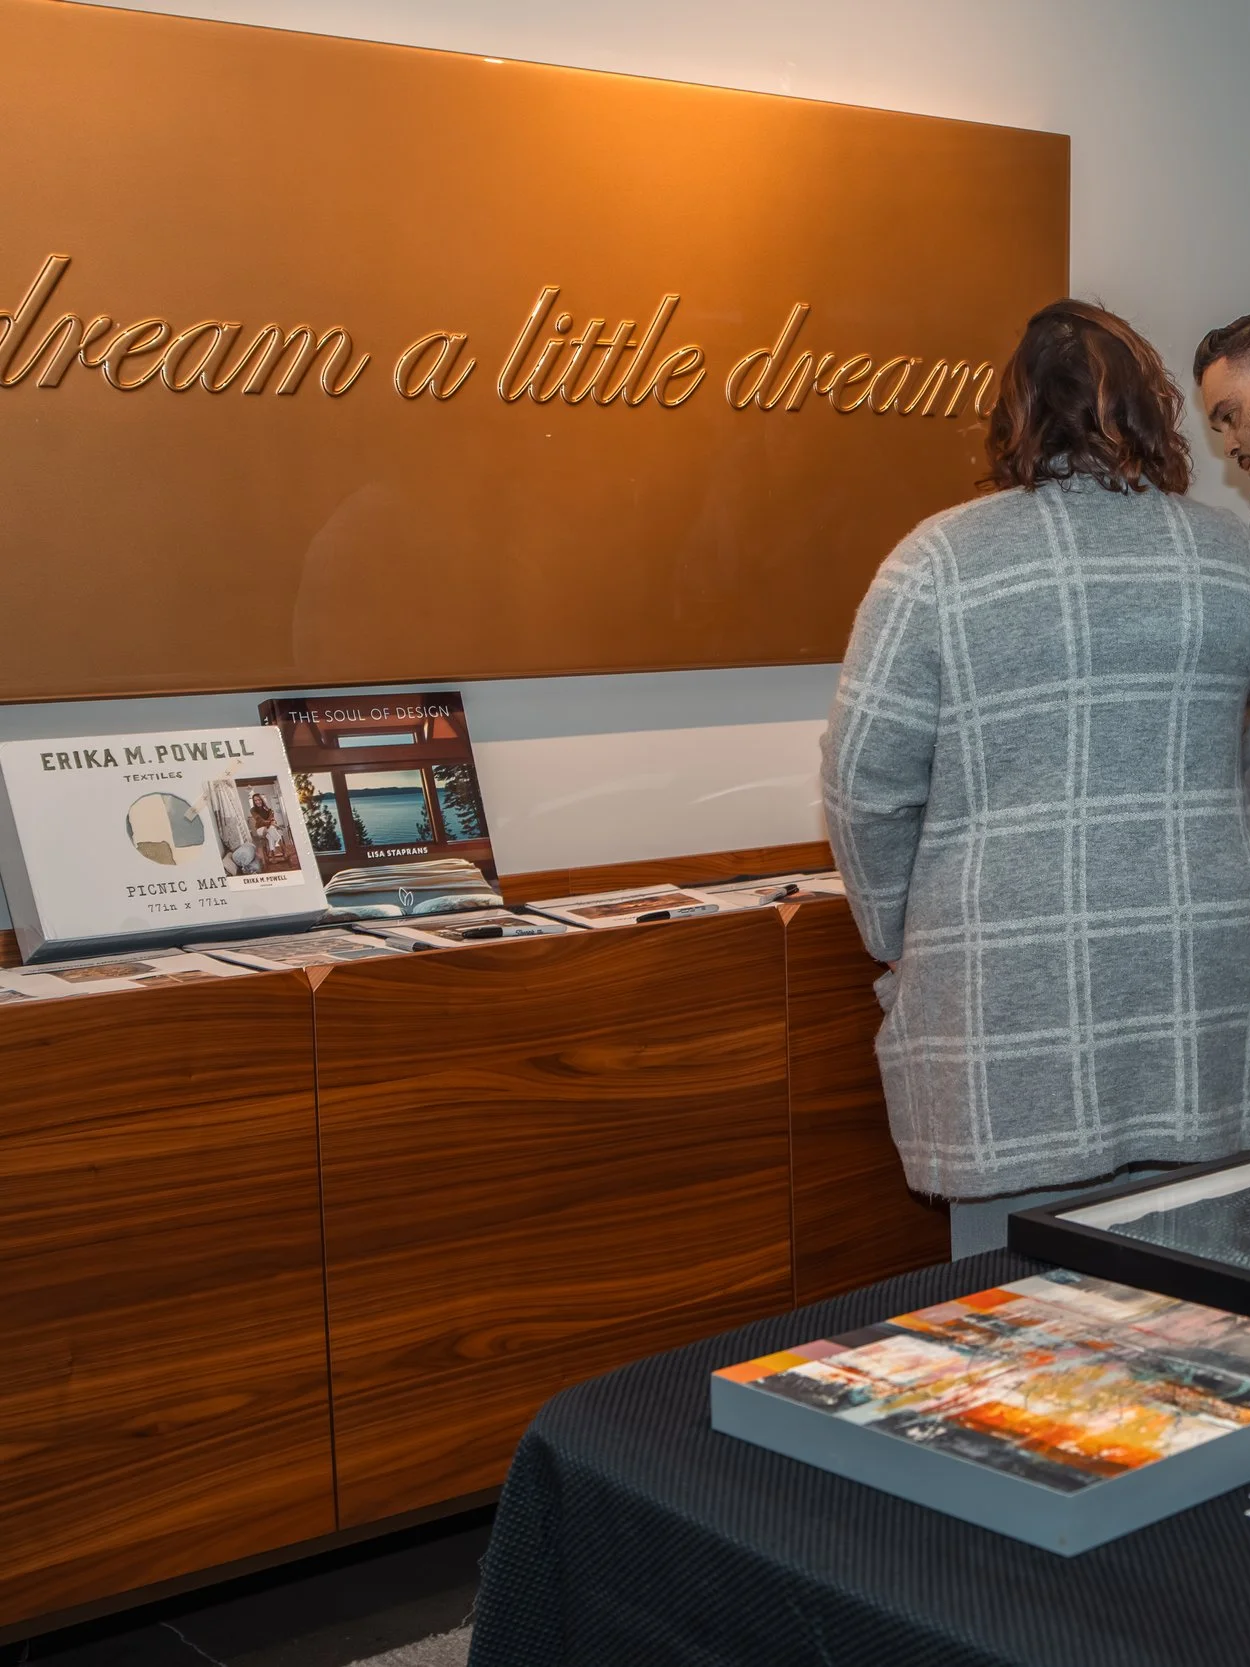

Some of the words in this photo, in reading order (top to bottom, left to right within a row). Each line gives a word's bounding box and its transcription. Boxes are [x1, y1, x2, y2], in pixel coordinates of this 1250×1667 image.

[0, 254, 370, 397] dream
[393, 331, 477, 401] a
[497, 284, 707, 409] little
[725, 302, 1000, 419] dream
[289, 711, 320, 724] THE
[325, 709, 366, 723] SOUL
[370, 707, 390, 721] OF
[396, 705, 450, 720] DESIGN
[40, 748, 119, 771] ERIKA
[154, 739, 255, 764] POWELL
[123, 771, 183, 783] TEXTILES
[367, 850, 385, 859] LISA
[386, 846, 428, 857] STAPRANS
[126, 880, 188, 898] PICNIC
[197, 876, 228, 891] MAT
[148, 902, 178, 913] 77in
[198, 897, 228, 908] 77in
